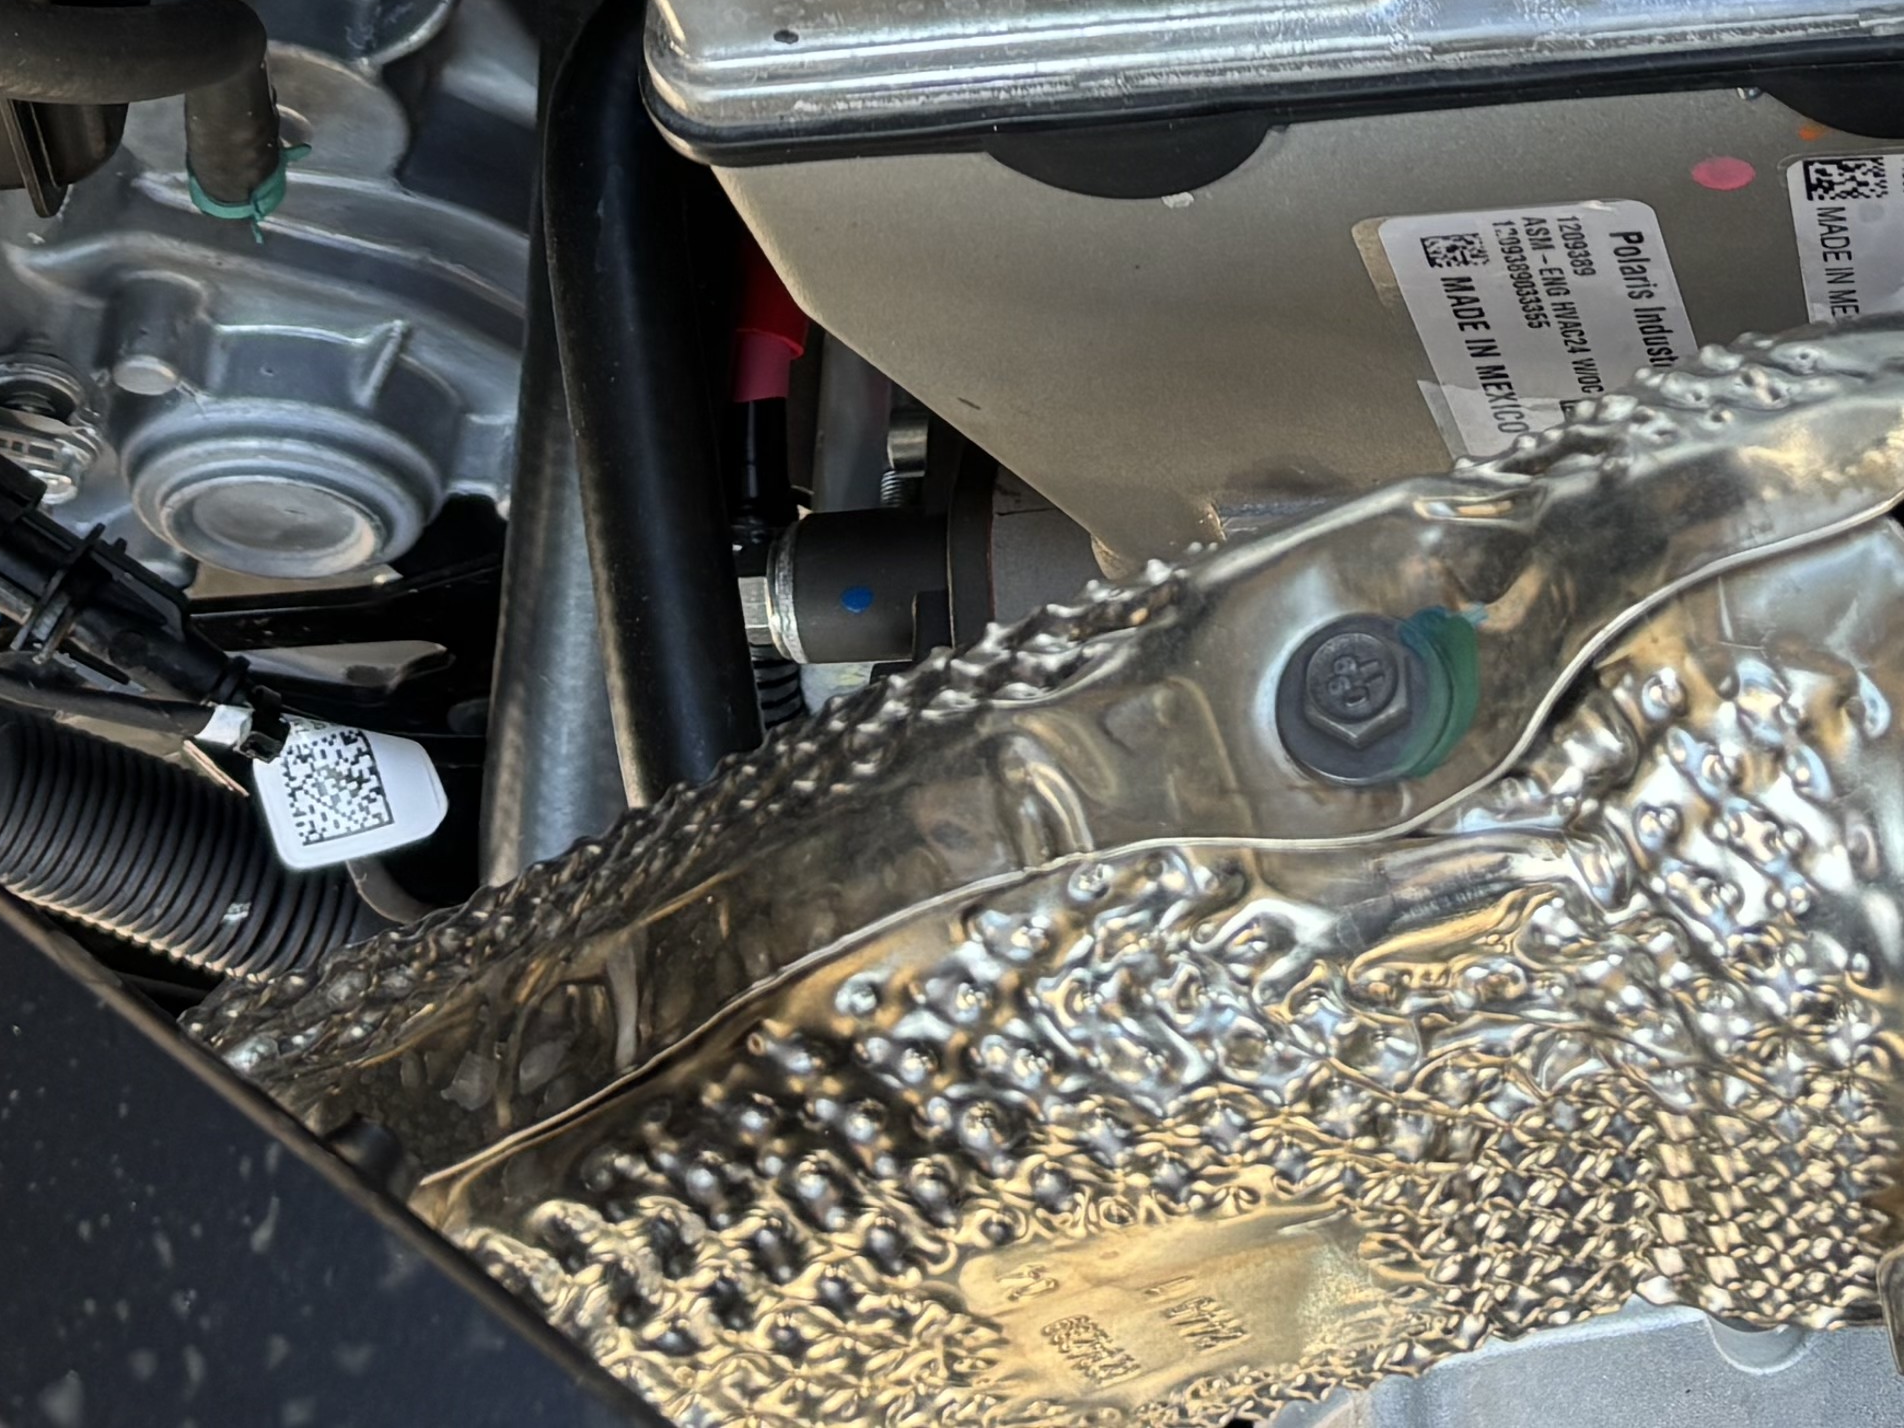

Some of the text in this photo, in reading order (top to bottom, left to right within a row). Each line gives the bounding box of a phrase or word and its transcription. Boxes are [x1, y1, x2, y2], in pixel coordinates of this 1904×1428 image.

[1521, 216, 1556, 251] ASM
[1556, 215, 1597, 277] 1209389
[1817, 207, 1860, 318] MADE IN ME
[1538, 267, 1571, 298] ENG
[1609, 231, 1658, 300] Polaris
[1440, 276, 1531, 434] MADE IN MEXICO
[1551, 301, 1592, 354] HVAC24
